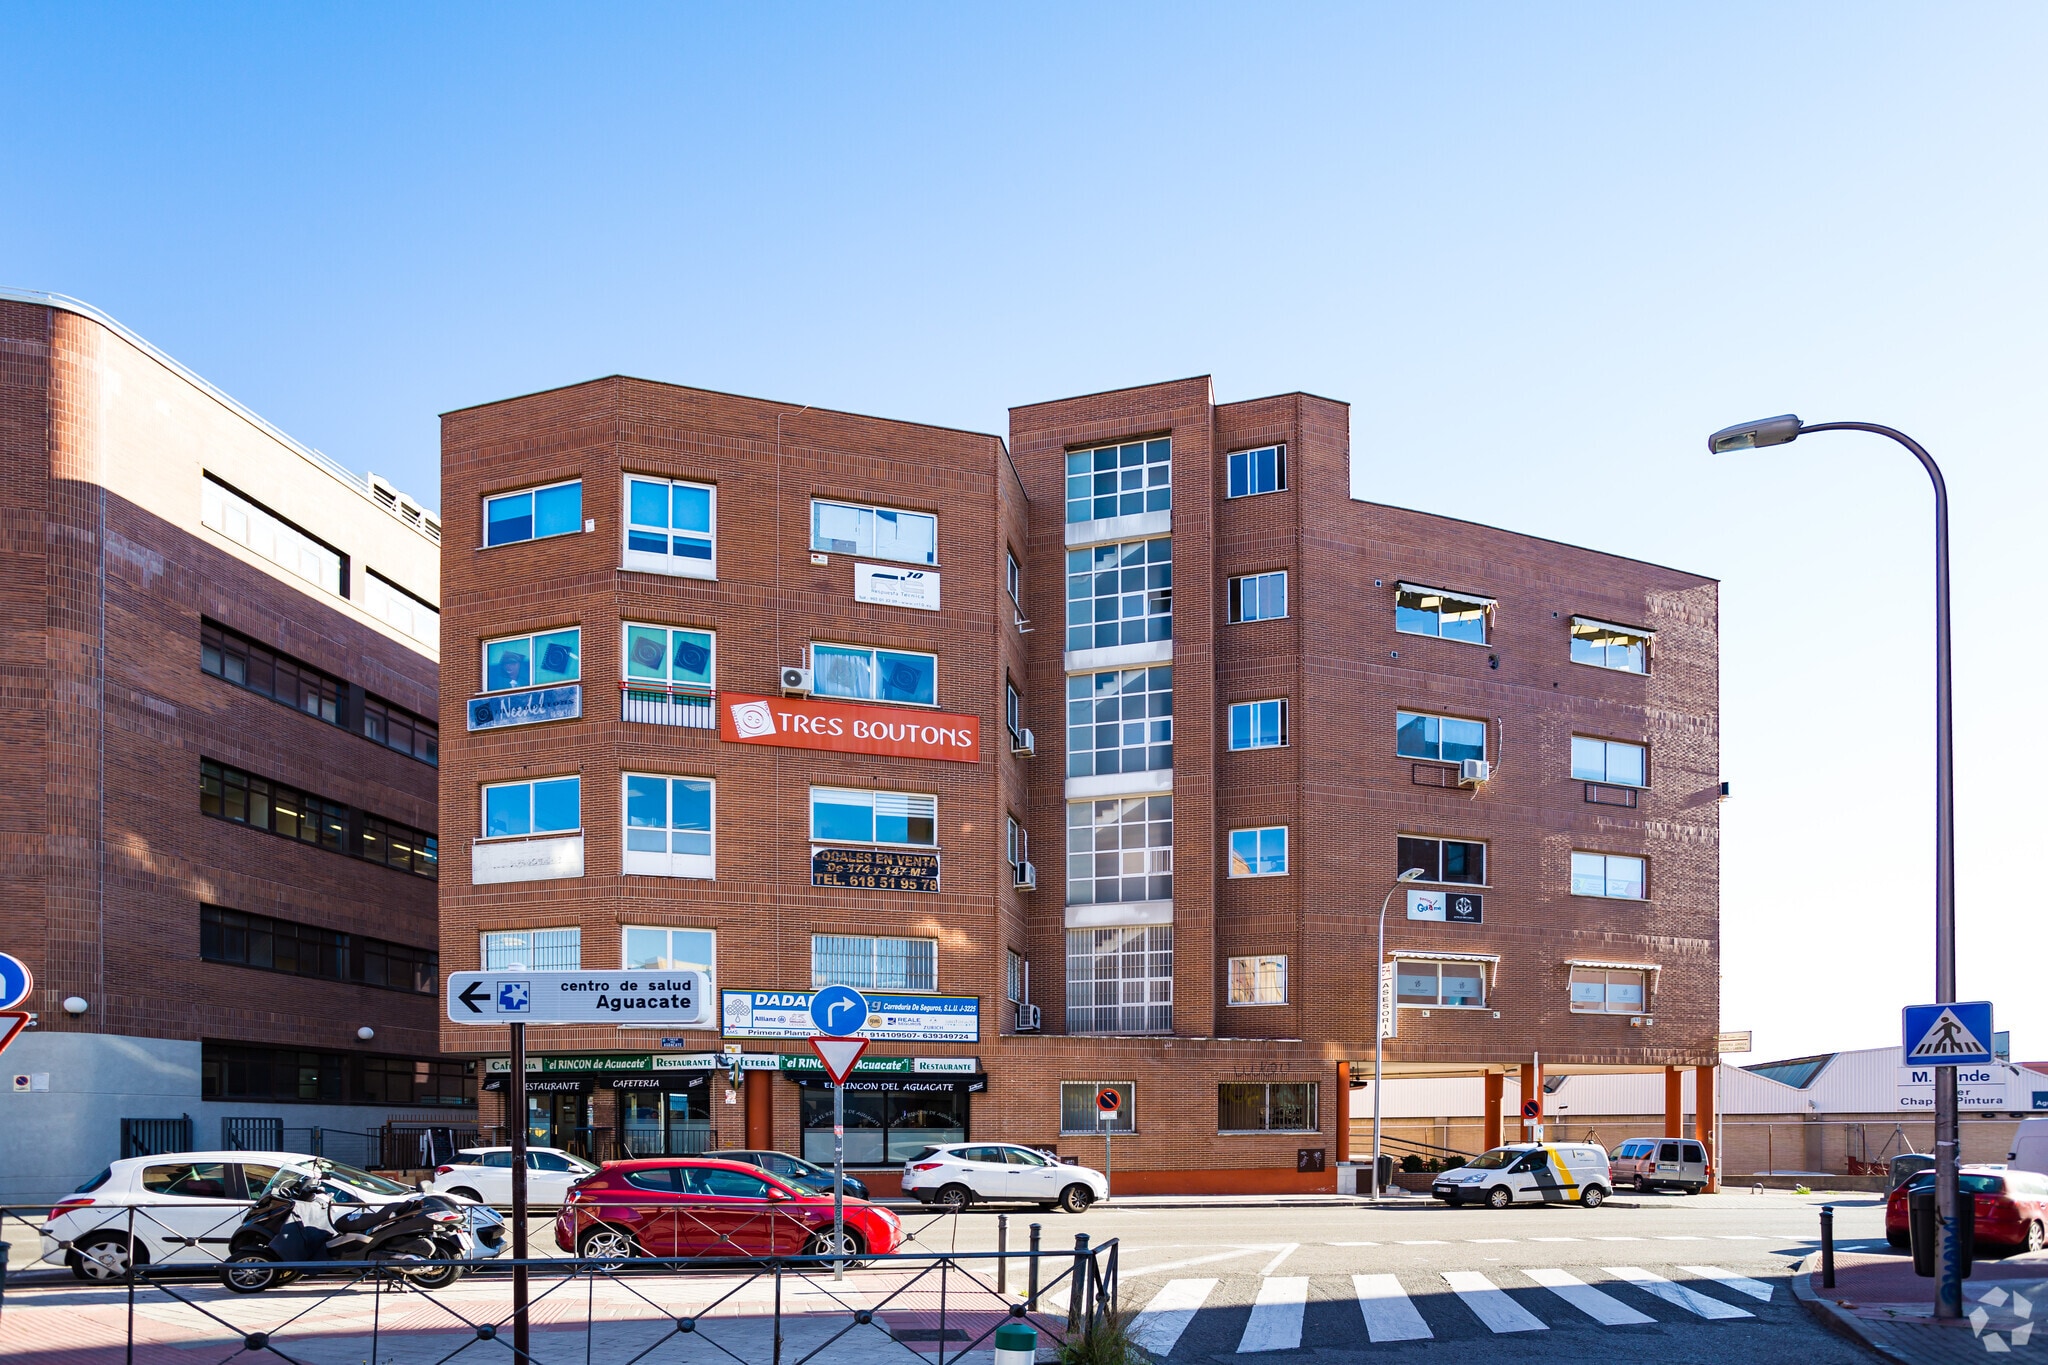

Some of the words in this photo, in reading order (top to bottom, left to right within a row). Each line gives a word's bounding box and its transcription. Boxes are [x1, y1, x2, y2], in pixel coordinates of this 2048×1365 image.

[778, 712, 843, 736] TRES
[853, 720, 972, 748] BOUTONS
[815, 851, 872, 864] OCALES
[876, 854, 893, 865] EN
[896, 855, 938, 868] VENTA
[827, 862, 844, 873] De
[814, 873, 846, 886] TEL.
[849, 876, 876, 888] 618
[880, 877, 895, 889] 51
[900, 878, 917, 890] 95
[921, 879, 937, 891] 78
[561, 980, 610, 992] centro
[620, 980, 638, 991] de
[648, 980, 692, 991] salud
[596, 994, 692, 1012] Aguacate
[1382, 982, 1390, 1037] ASESORIA
[558, 1059, 592, 1069] RINCON
[593, 1058, 604, 1069] de
[1912, 1071, 1932, 1083] M.
[525, 1081, 580, 1091] ESTAURANTE
[612, 1079, 660, 1088] CAFETERIA
[881, 1083, 900, 1091] DEL
[902, 1083, 954, 1092] AGUACATE
[1900, 1097, 1936, 1107] Chap
